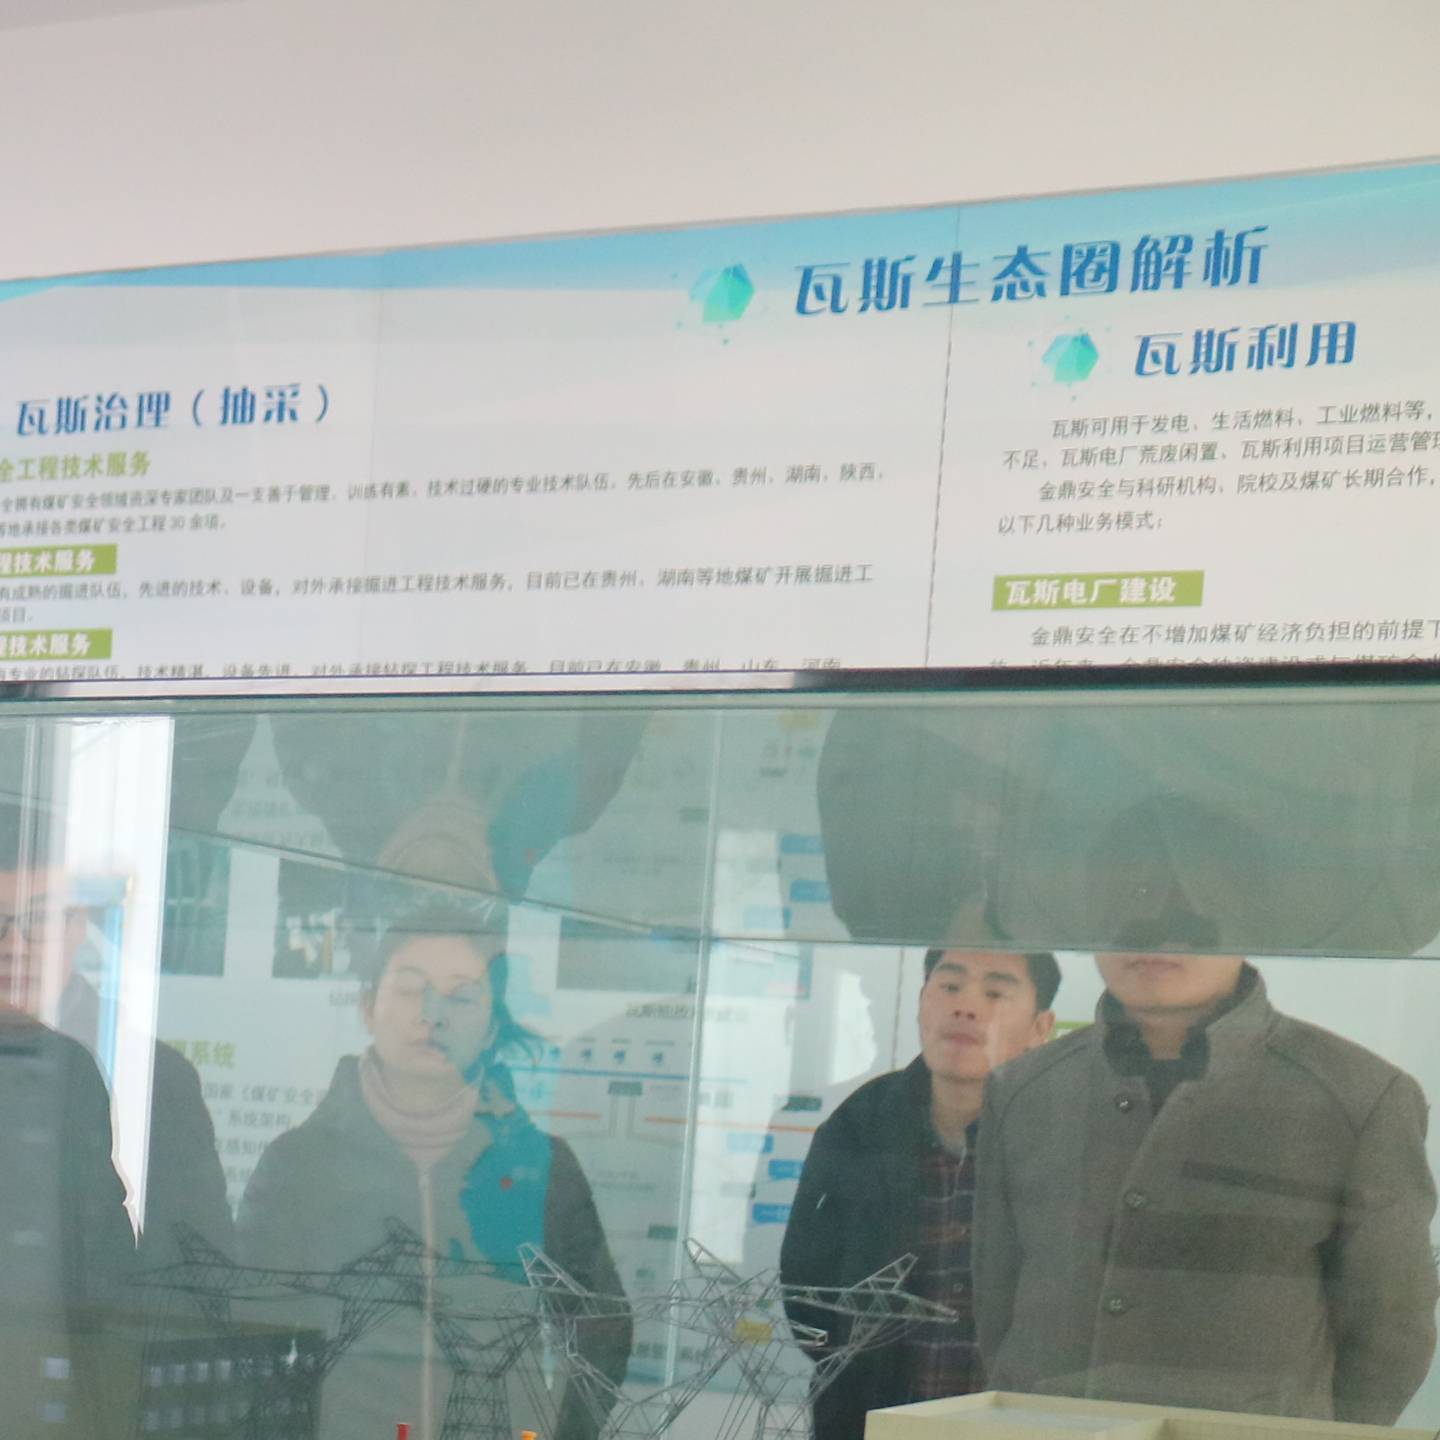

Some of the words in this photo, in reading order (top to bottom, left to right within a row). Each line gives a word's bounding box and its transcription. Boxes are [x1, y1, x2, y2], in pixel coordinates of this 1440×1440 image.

[793, 225, 1270, 317] 瓦斯生态圈解析
[1133, 320, 1359, 378] 瓦斯利用
[16, 382, 329, 437] 瓦斯治理（抽采）
[1006, 576, 1178, 606] 瓦斯电厂建设
